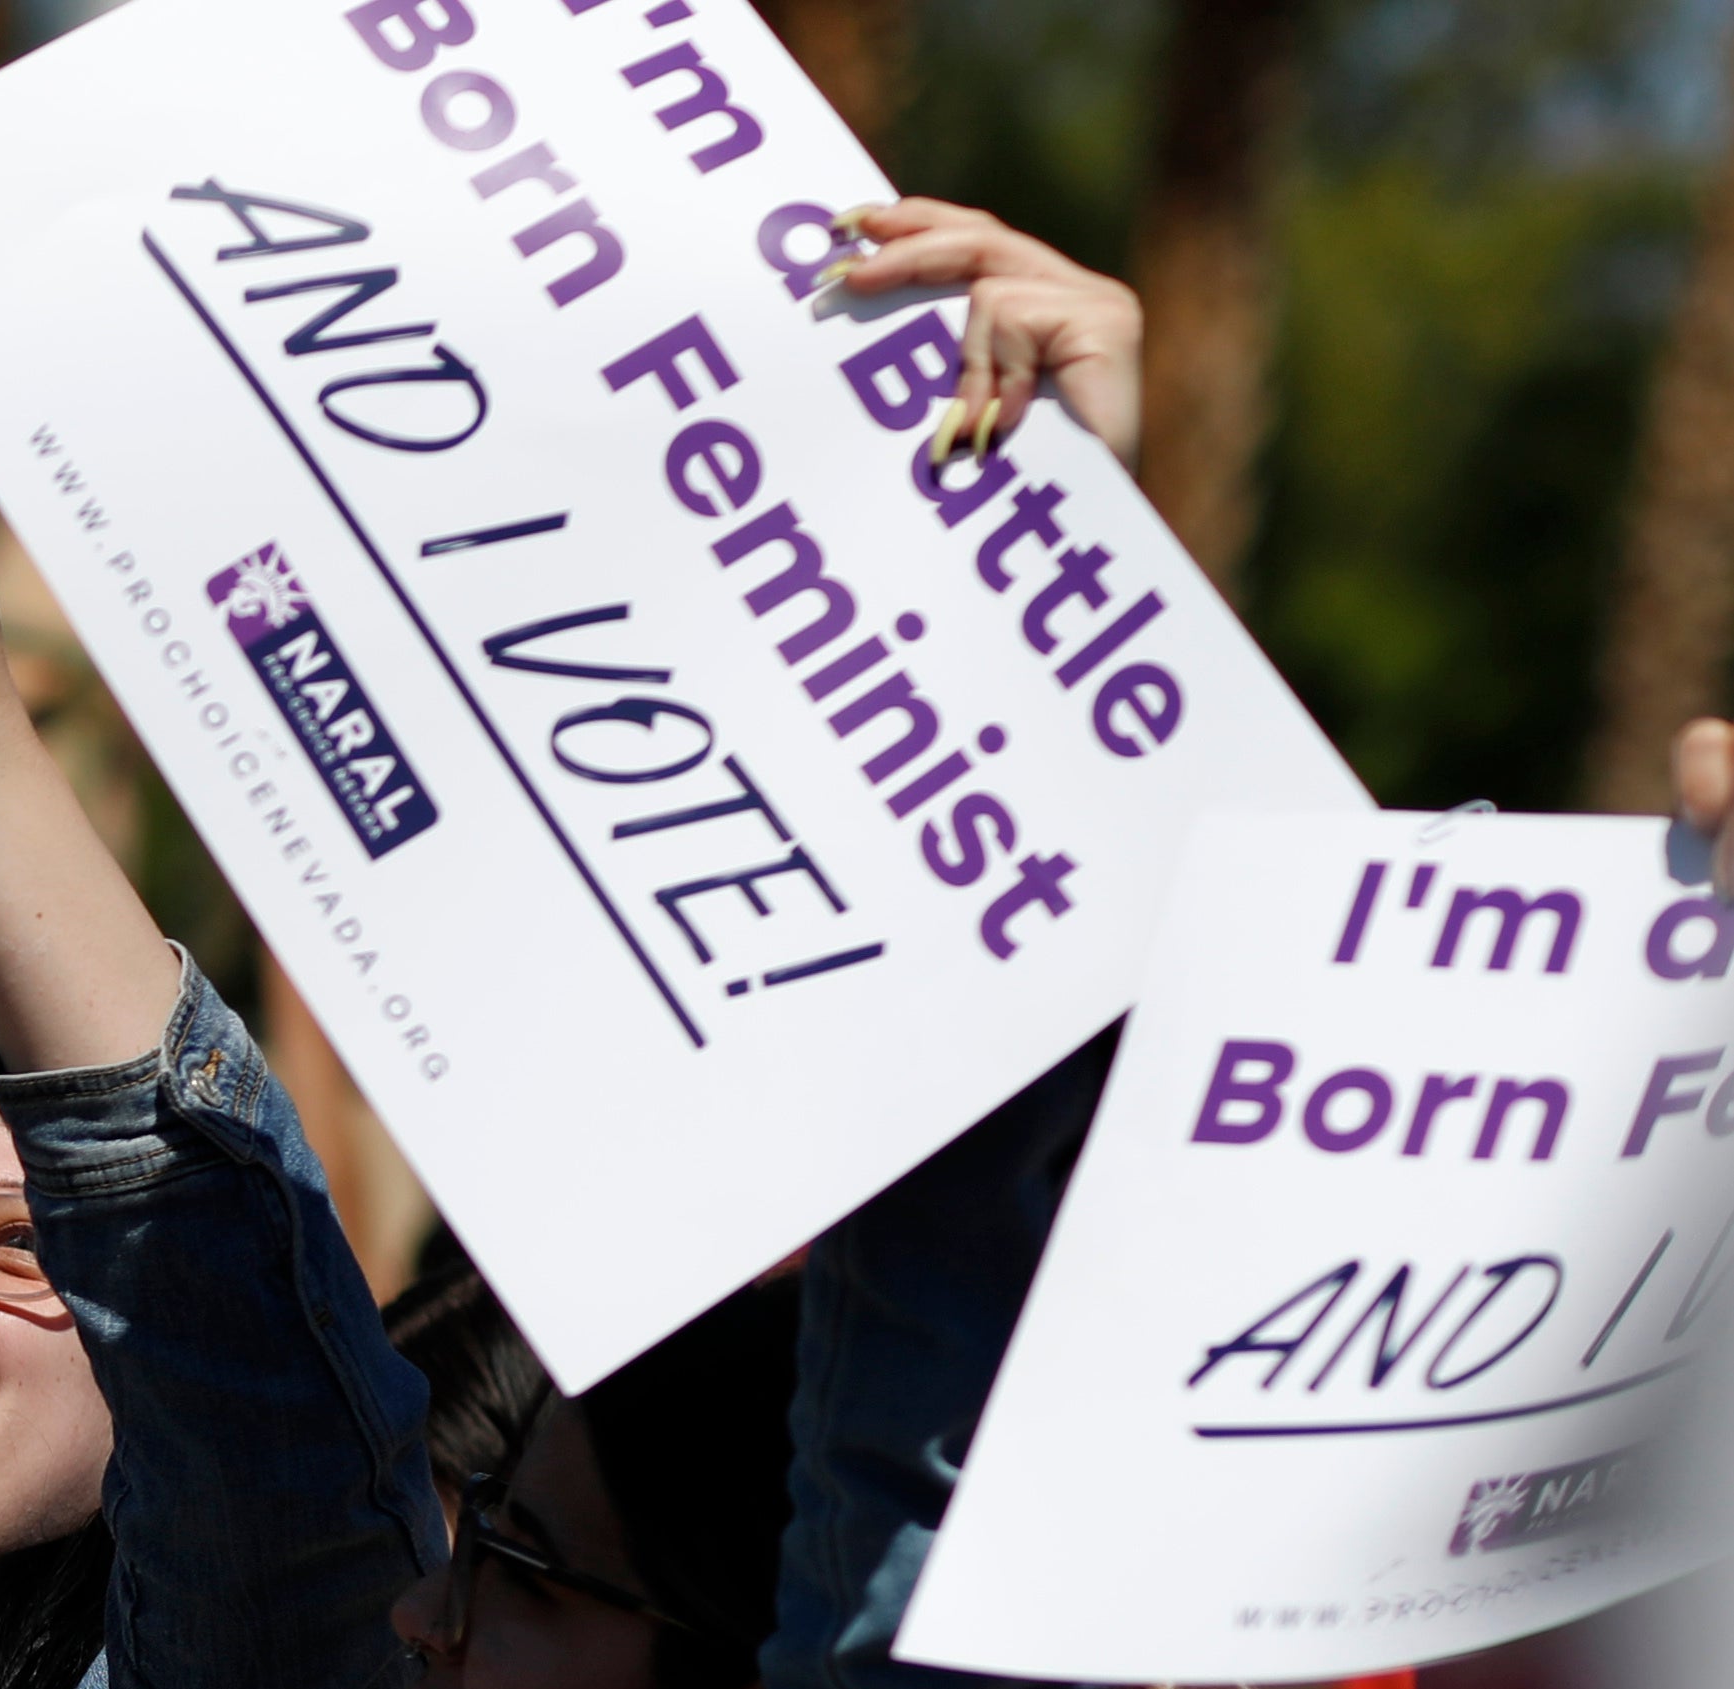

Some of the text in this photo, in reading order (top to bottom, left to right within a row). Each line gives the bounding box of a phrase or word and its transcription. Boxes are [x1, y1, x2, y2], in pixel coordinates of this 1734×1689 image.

[343, 0, 1077, 962] Born Feminist
[838, 309, 1185, 759] Battle
[170, 178, 885, 998] AND I VOTE!
[277, 629, 416, 832] NARAL
[1332, 861, 1584, 974] I'm
[1189, 1038, 1572, 1162] Born
[1186, 1253, 1565, 1395] AND
[1580, 1225, 1675, 1371] I
